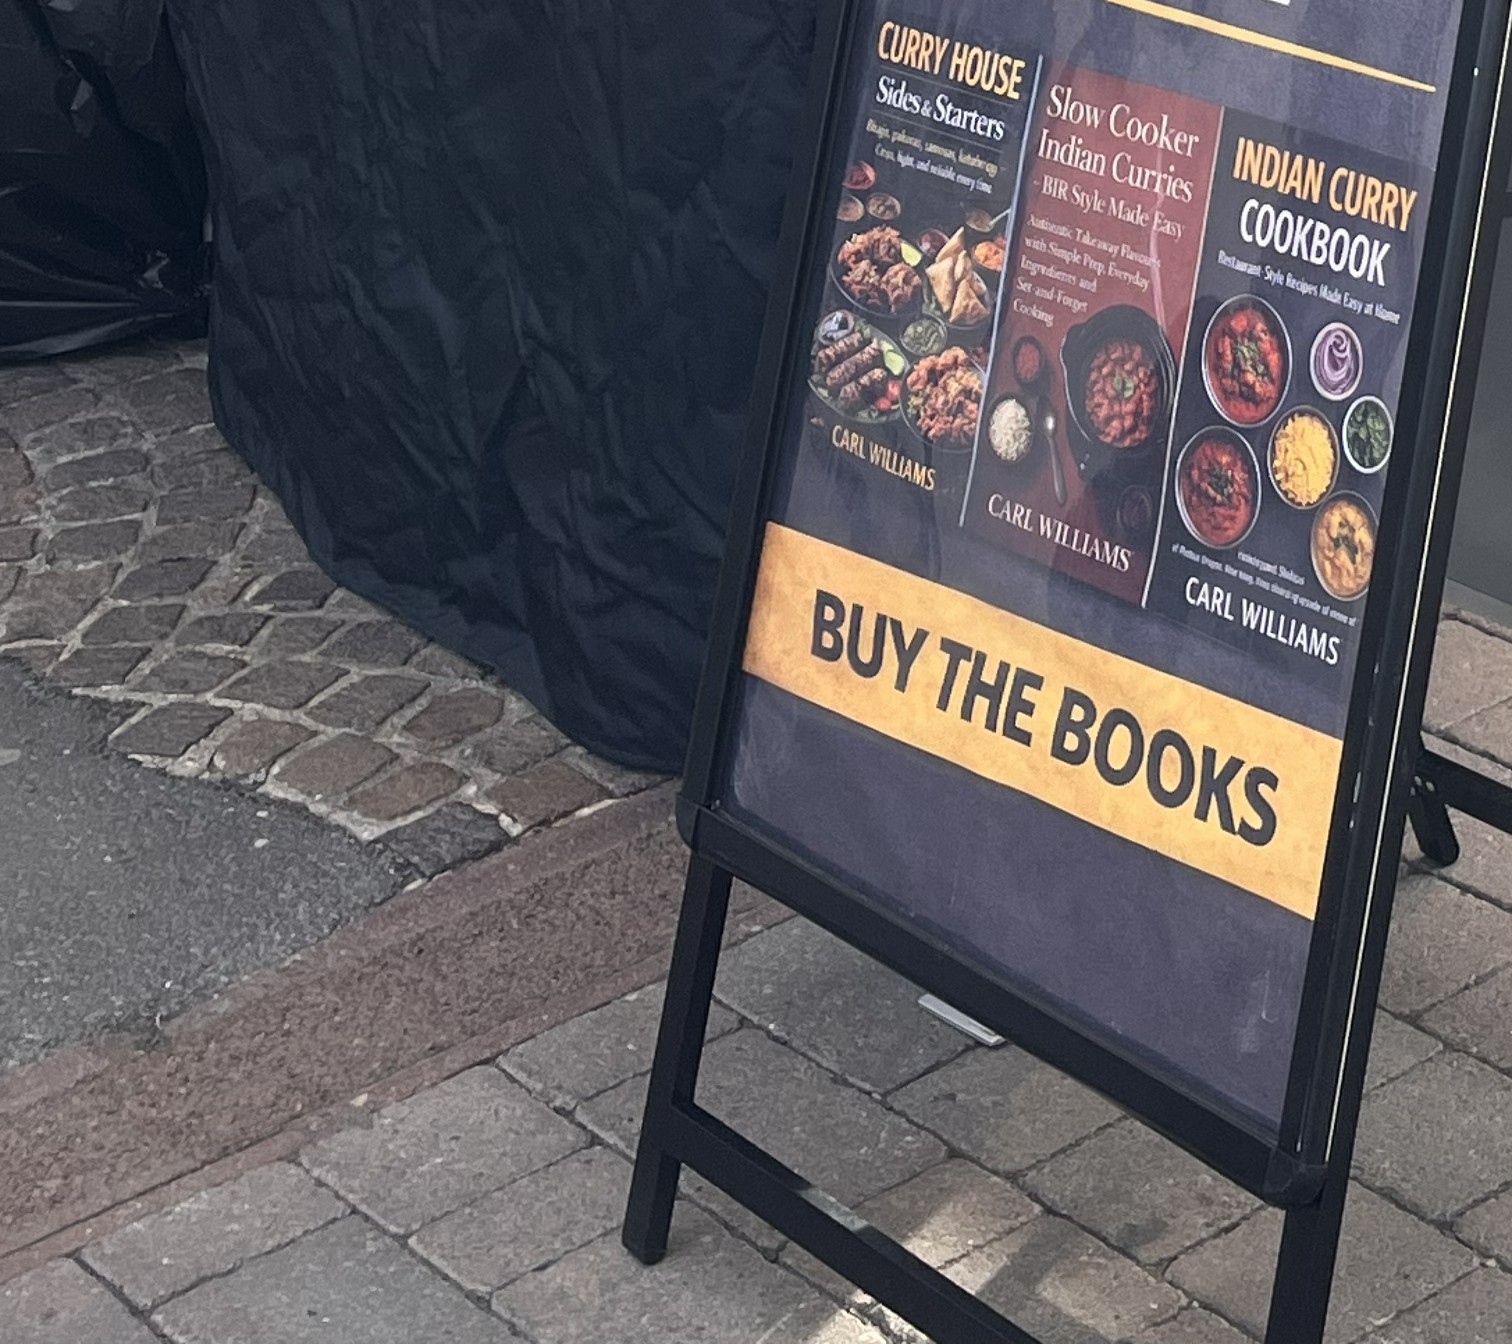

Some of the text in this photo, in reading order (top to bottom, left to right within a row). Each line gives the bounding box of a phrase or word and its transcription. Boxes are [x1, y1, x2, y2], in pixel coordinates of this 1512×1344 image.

[877, 21, 1026, 100] CURRY HOUSE
[875, 75, 1005, 141] Sides & Starters
[1046, 83, 1200, 158] Slow Cooker
[1038, 127, 1106, 177] Indian
[1112, 151, 1194, 203] Curries
[1232, 136, 1418, 232] INDIAN CURRY
[1041, 174, 1185, 243] BIR Style Made Easy
[1075, 227, 1120, 258] Takeaway
[1240, 198, 1391, 287] COOKBOOK
[1020, 254, 1098, 293] Ingredients and
[1024, 236, 1047, 253] with
[1048, 241, 1082, 265] Simple
[1108, 262, 1150, 292] Everyday
[1285, 272, 1319, 297] Recipes
[1319, 284, 1342, 305] Made
[1343, 292, 1363, 315] Easy
[1013, 298, 1055, 328] Cooking
[832, 424, 937, 491] CARL WILLIAMS
[988, 493, 1033, 532] CARL
[1038, 514, 1132, 573] WILLIAMS
[1185, 576, 1235, 622] CARL
[1242, 597, 1341, 665] WILLIAMS
[809, 589, 1280, 848] BUY THE BOOKS
